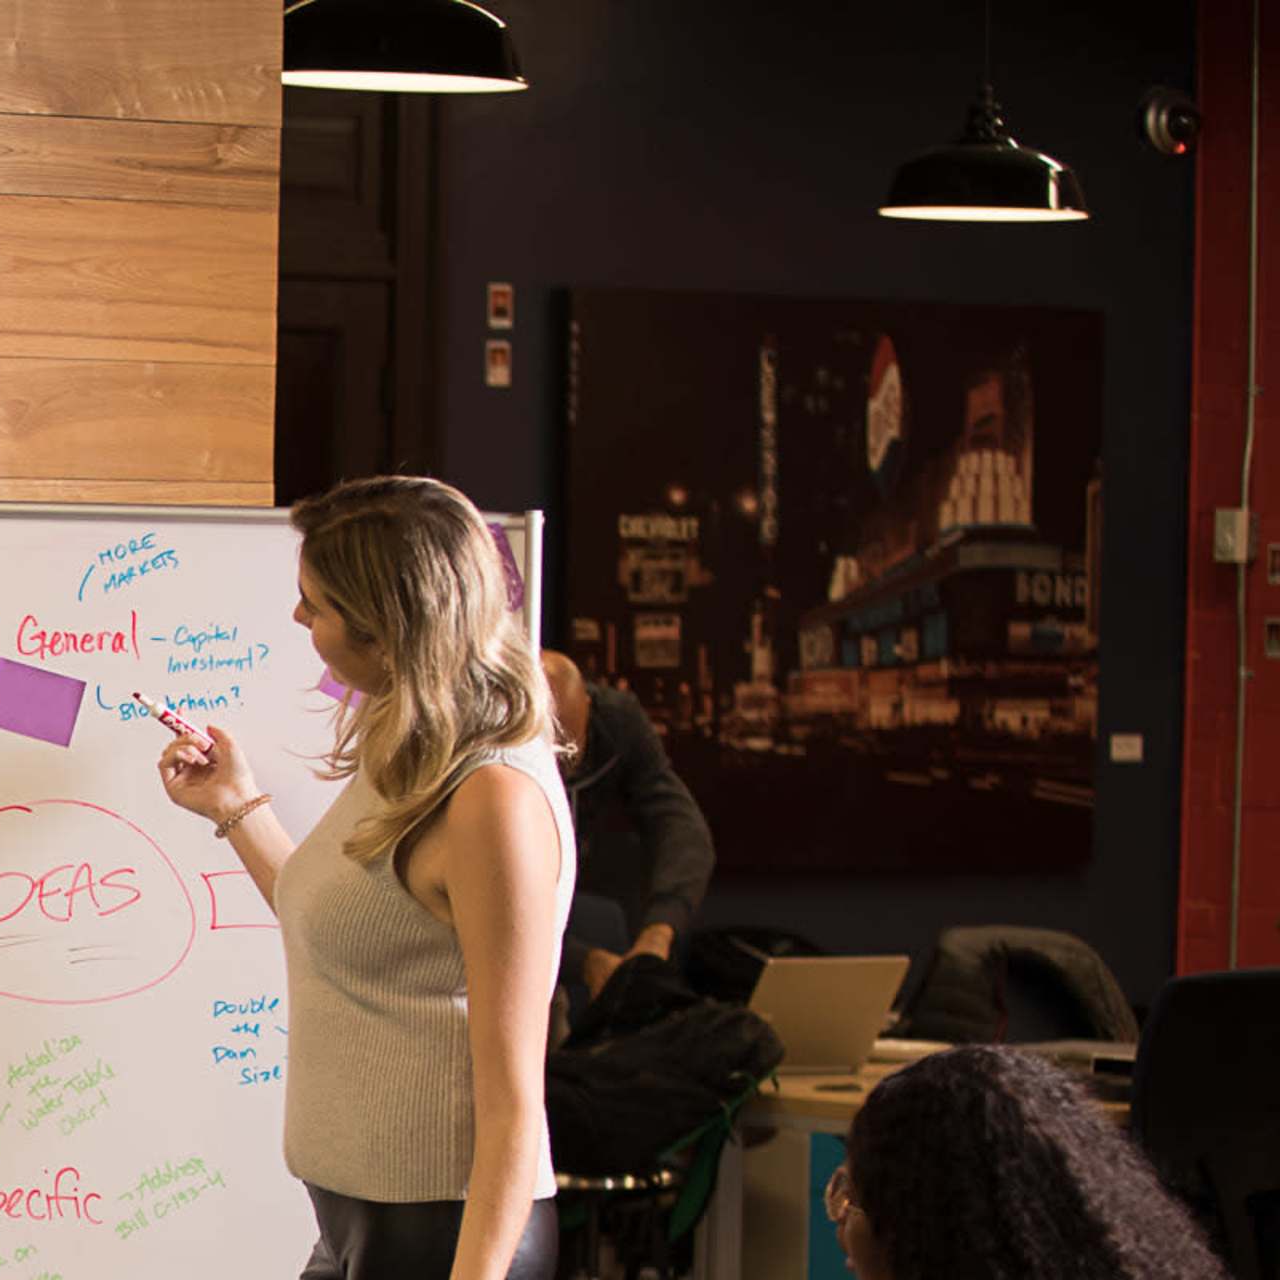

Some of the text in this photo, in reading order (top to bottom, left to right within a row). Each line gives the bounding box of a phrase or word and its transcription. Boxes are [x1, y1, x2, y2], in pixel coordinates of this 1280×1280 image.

[98, 532, 157, 567] MORE
[102, 550, 180, 593] MARKETS
[16, 610, 140, 660] General
